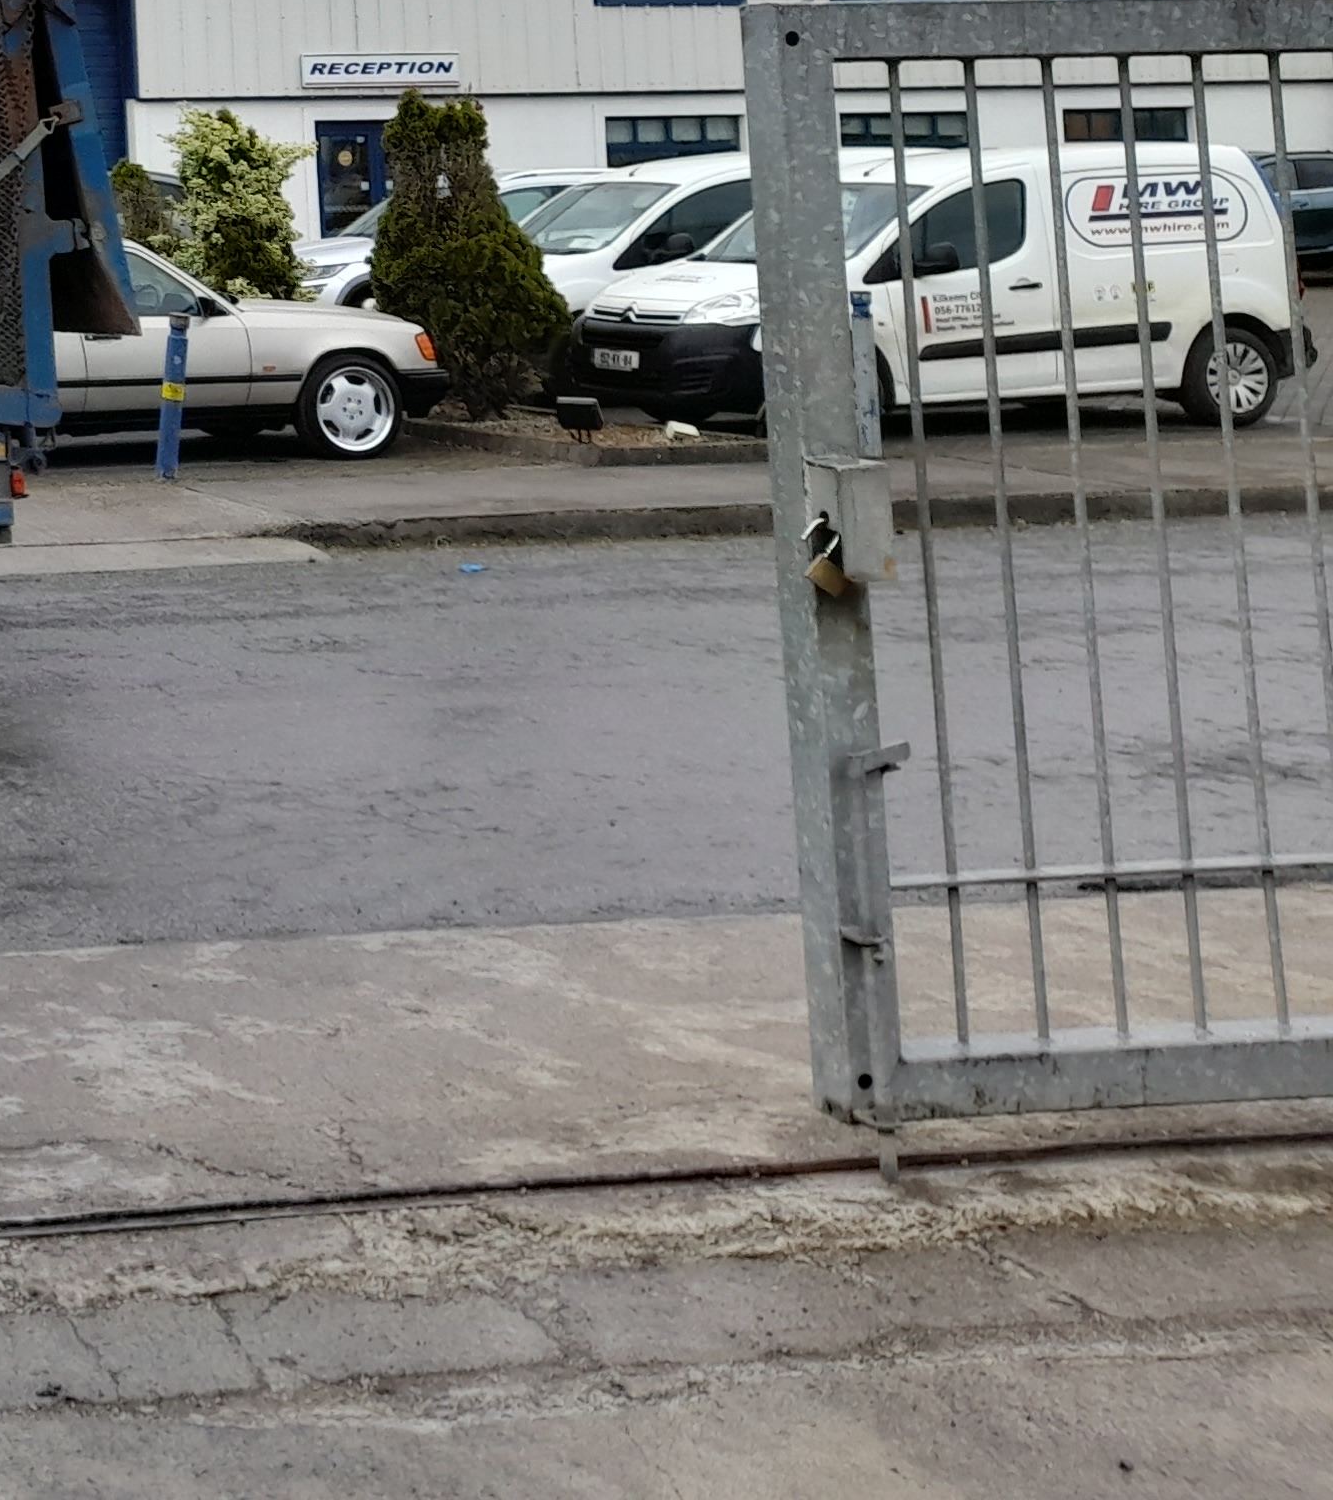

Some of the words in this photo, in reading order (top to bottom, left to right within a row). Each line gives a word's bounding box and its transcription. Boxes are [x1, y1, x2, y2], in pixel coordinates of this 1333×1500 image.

[310, 61, 454, 76] RECEPTION
[1119, 201, 1163, 211] HRE
[1090, 221, 1230, 237] wwwwhire.cm
